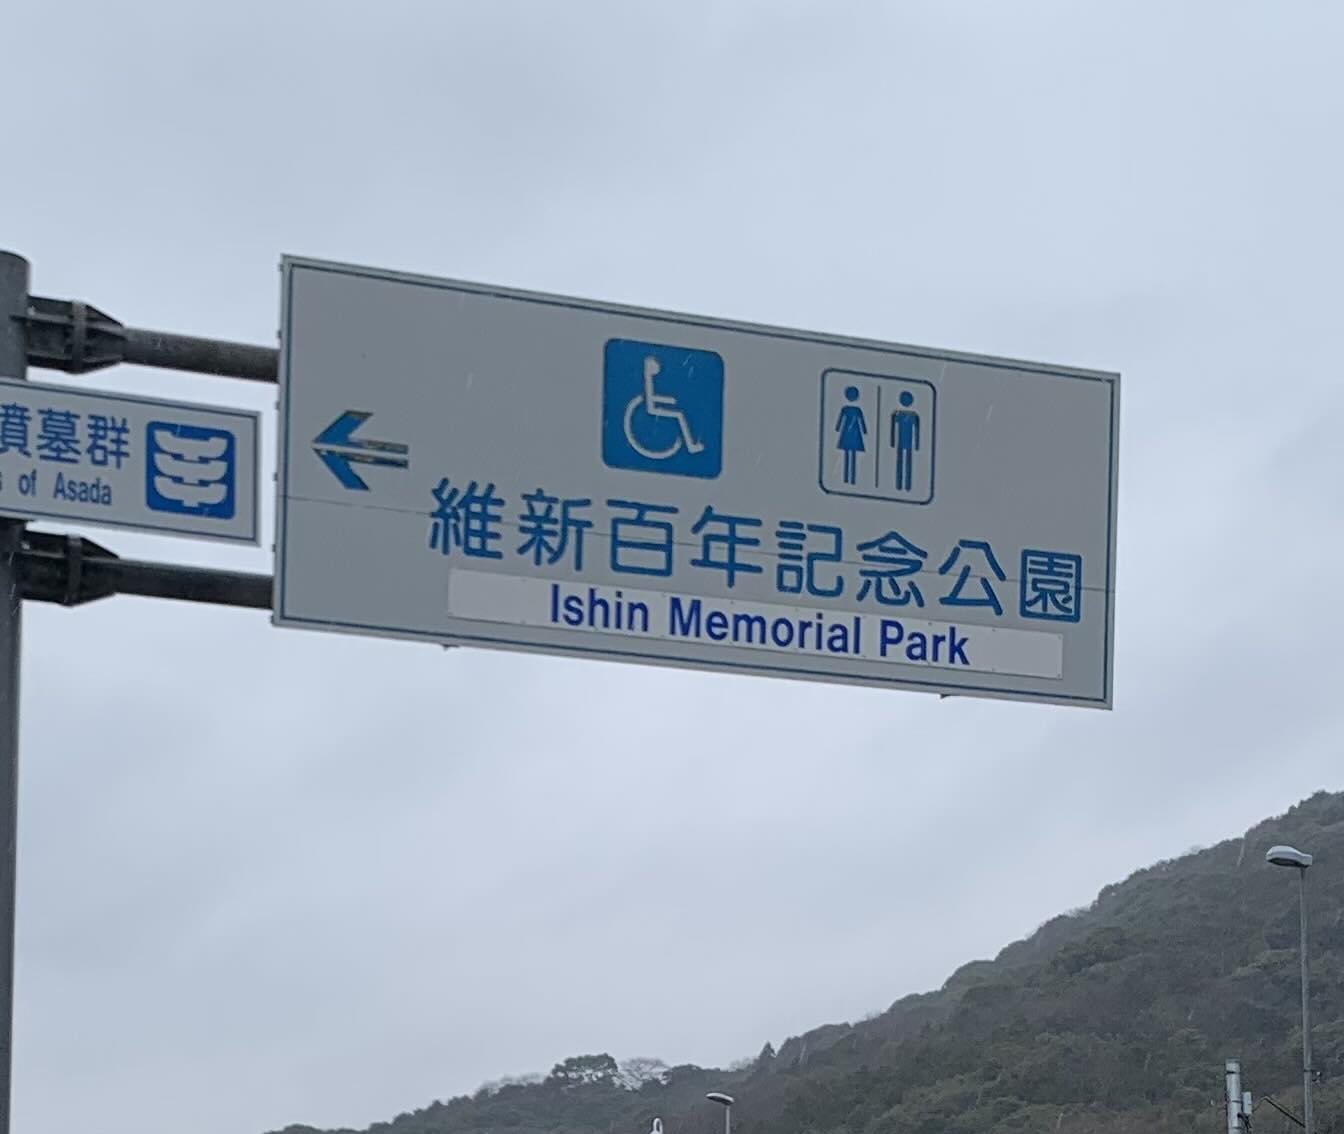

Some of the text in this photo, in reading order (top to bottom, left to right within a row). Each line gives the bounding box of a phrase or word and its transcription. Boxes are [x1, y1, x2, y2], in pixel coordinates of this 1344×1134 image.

[17, 469, 38, 496] of
[52, 471, 113, 506] Asada
[429, 477, 1083, 624] 維新百年記念公園
[551, 583, 971, 666] Ishin Memorial Park
